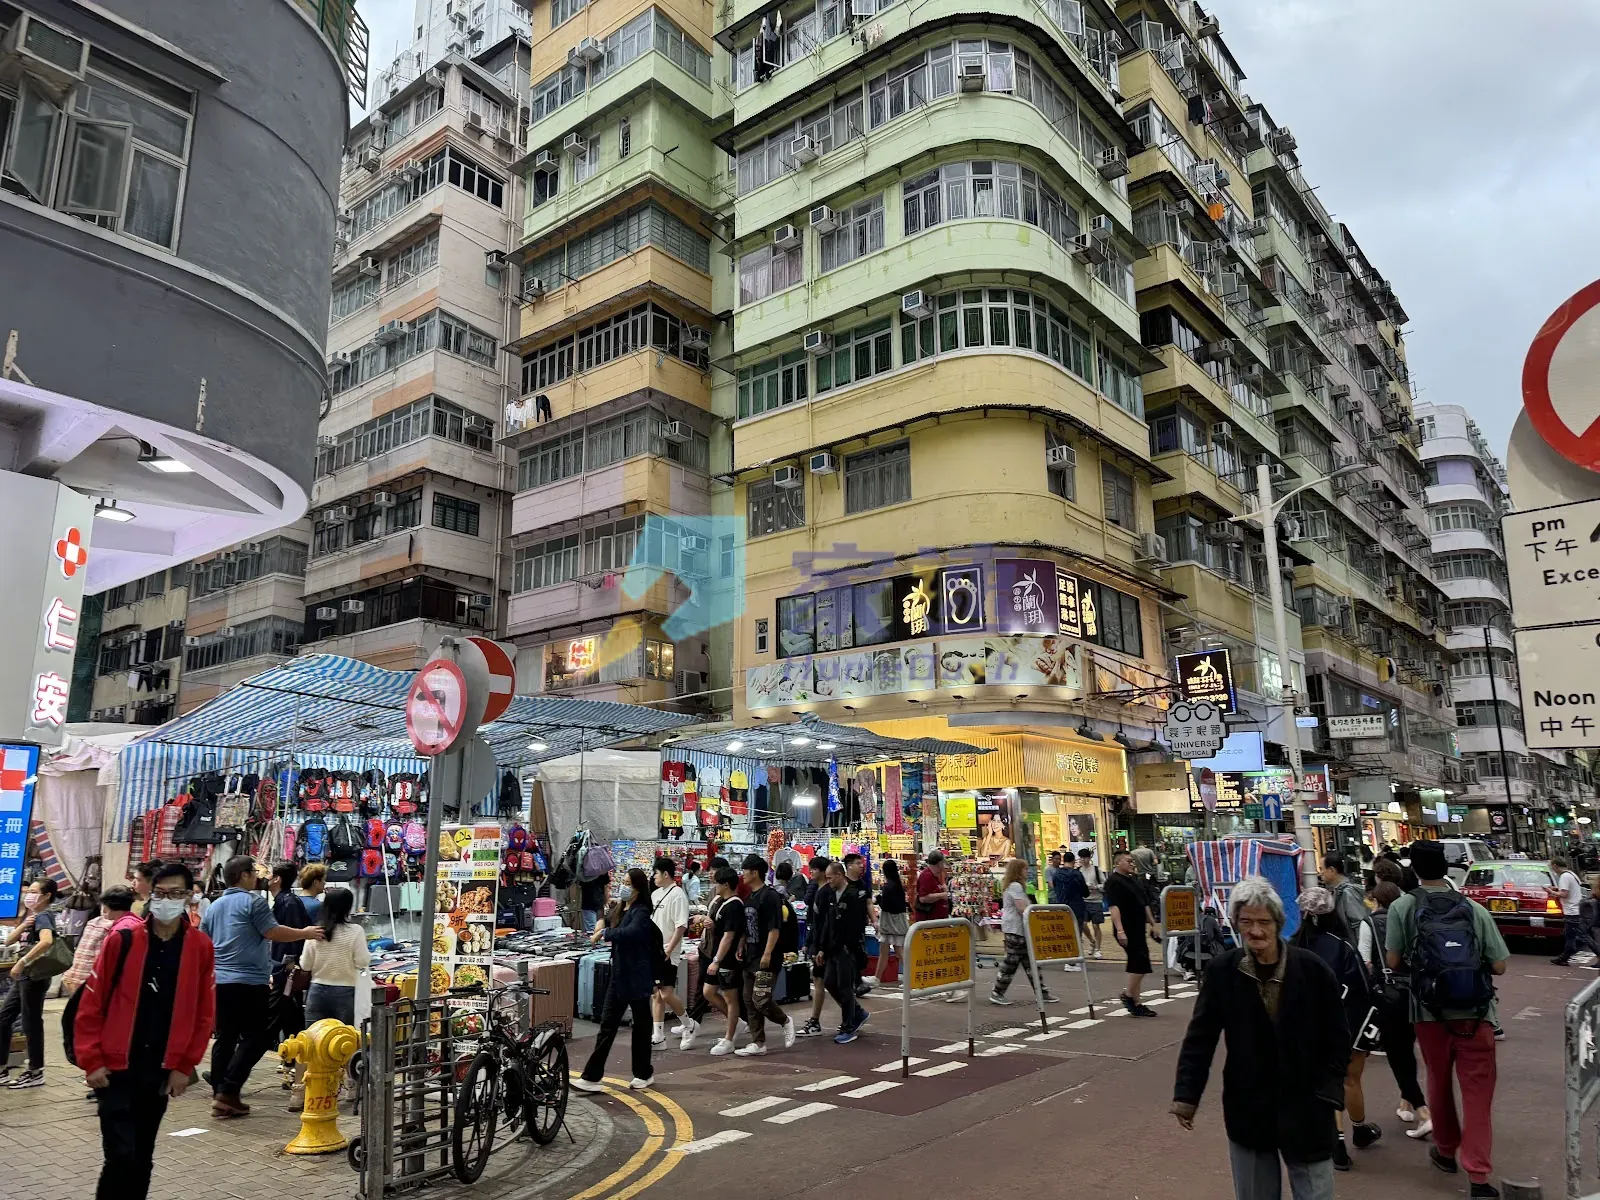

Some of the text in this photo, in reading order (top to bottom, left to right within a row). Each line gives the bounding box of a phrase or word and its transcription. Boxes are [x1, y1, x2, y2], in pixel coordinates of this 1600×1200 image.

[1532, 518, 1565, 538] pm
[1525, 538, 1578, 562] 下午
[33, 598, 77, 726] 仁安
[1534, 691, 1596, 706] Noon
[1540, 715, 1595, 738] 中午
[1174, 740, 1218, 749] UNIVERSE
[0, 818, 23, 833] 冊
[1, 843, 20, 858] 證
[0, 868, 17, 884] 貨
[308, 1096, 332, 1110] 275
